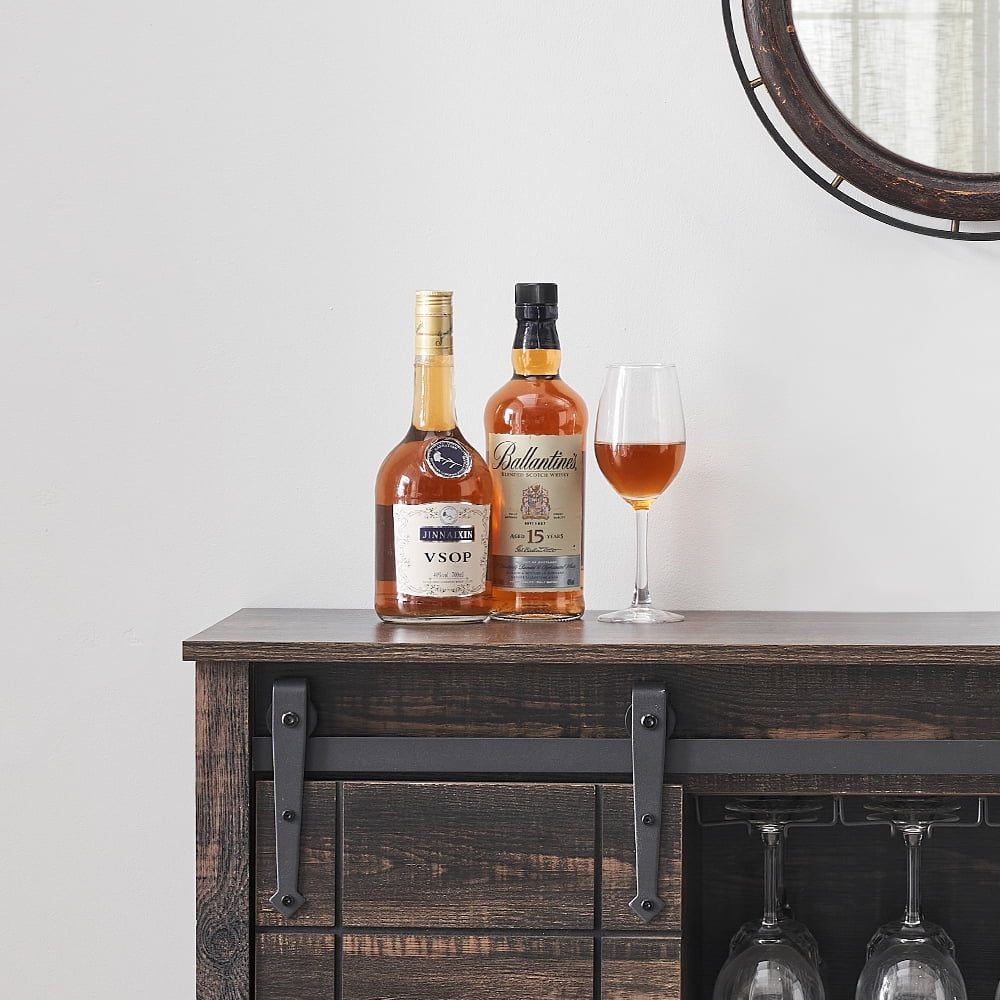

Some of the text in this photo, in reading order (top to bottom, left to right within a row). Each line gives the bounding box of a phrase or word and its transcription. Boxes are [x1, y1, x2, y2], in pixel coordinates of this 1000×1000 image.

[493, 441, 577, 471] Ballantine's
[422, 531, 473, 539] JINNAIXIN
[527, 529, 544, 543] 15
[424, 551, 472, 563] VSOP
